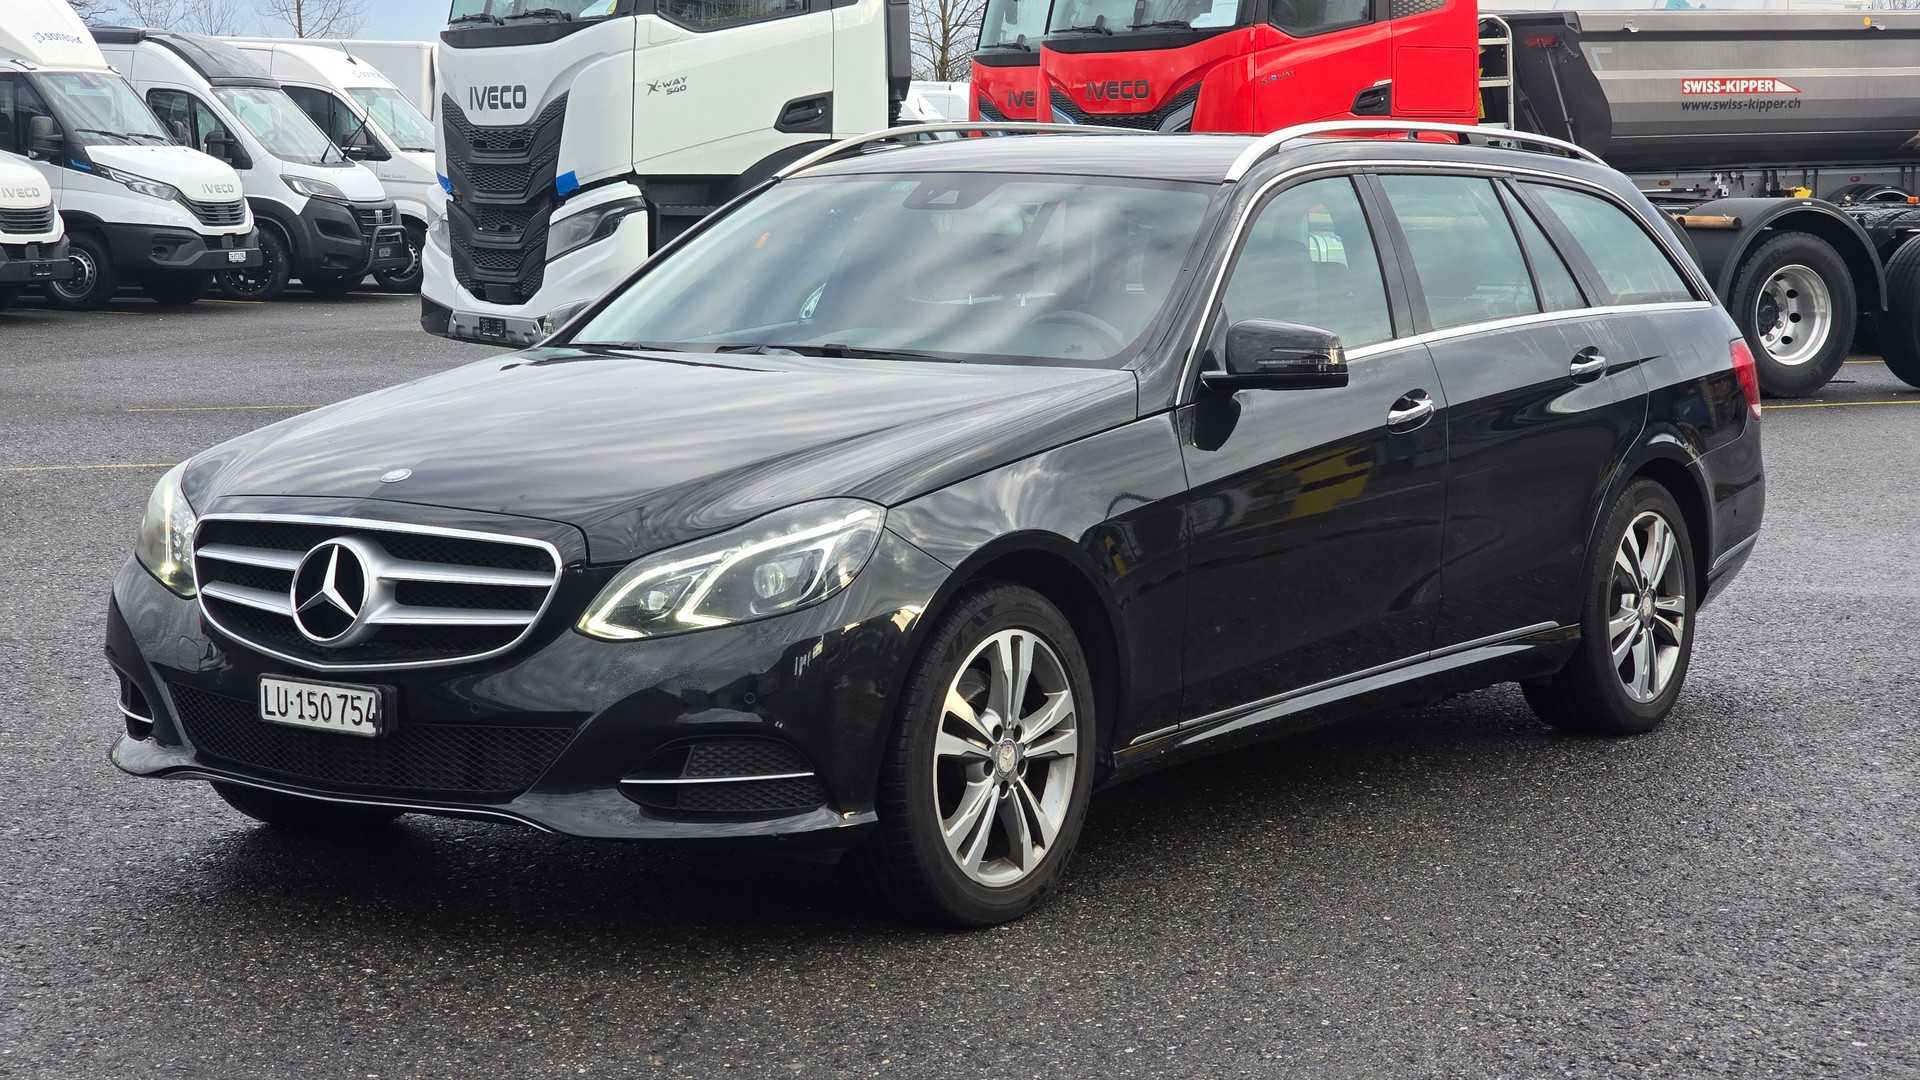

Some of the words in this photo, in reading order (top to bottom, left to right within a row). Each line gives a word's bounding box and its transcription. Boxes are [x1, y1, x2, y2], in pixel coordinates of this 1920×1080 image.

[647, 76, 688, 96] X-WAY
[666, 85, 687, 95] 540
[1086, 80, 1149, 100] IVECO
[1683, 79, 1774, 93] SWISS-KIPPER
[470, 85, 527, 110] IVECO
[1007, 91, 1038, 107] IVE
[1681, 98, 1801, 112] www.swiss-kipper.ch
[1, 187, 40, 198] IVECO
[201, 183, 235, 193] IVECO
[337, 694, 376, 728] 754
